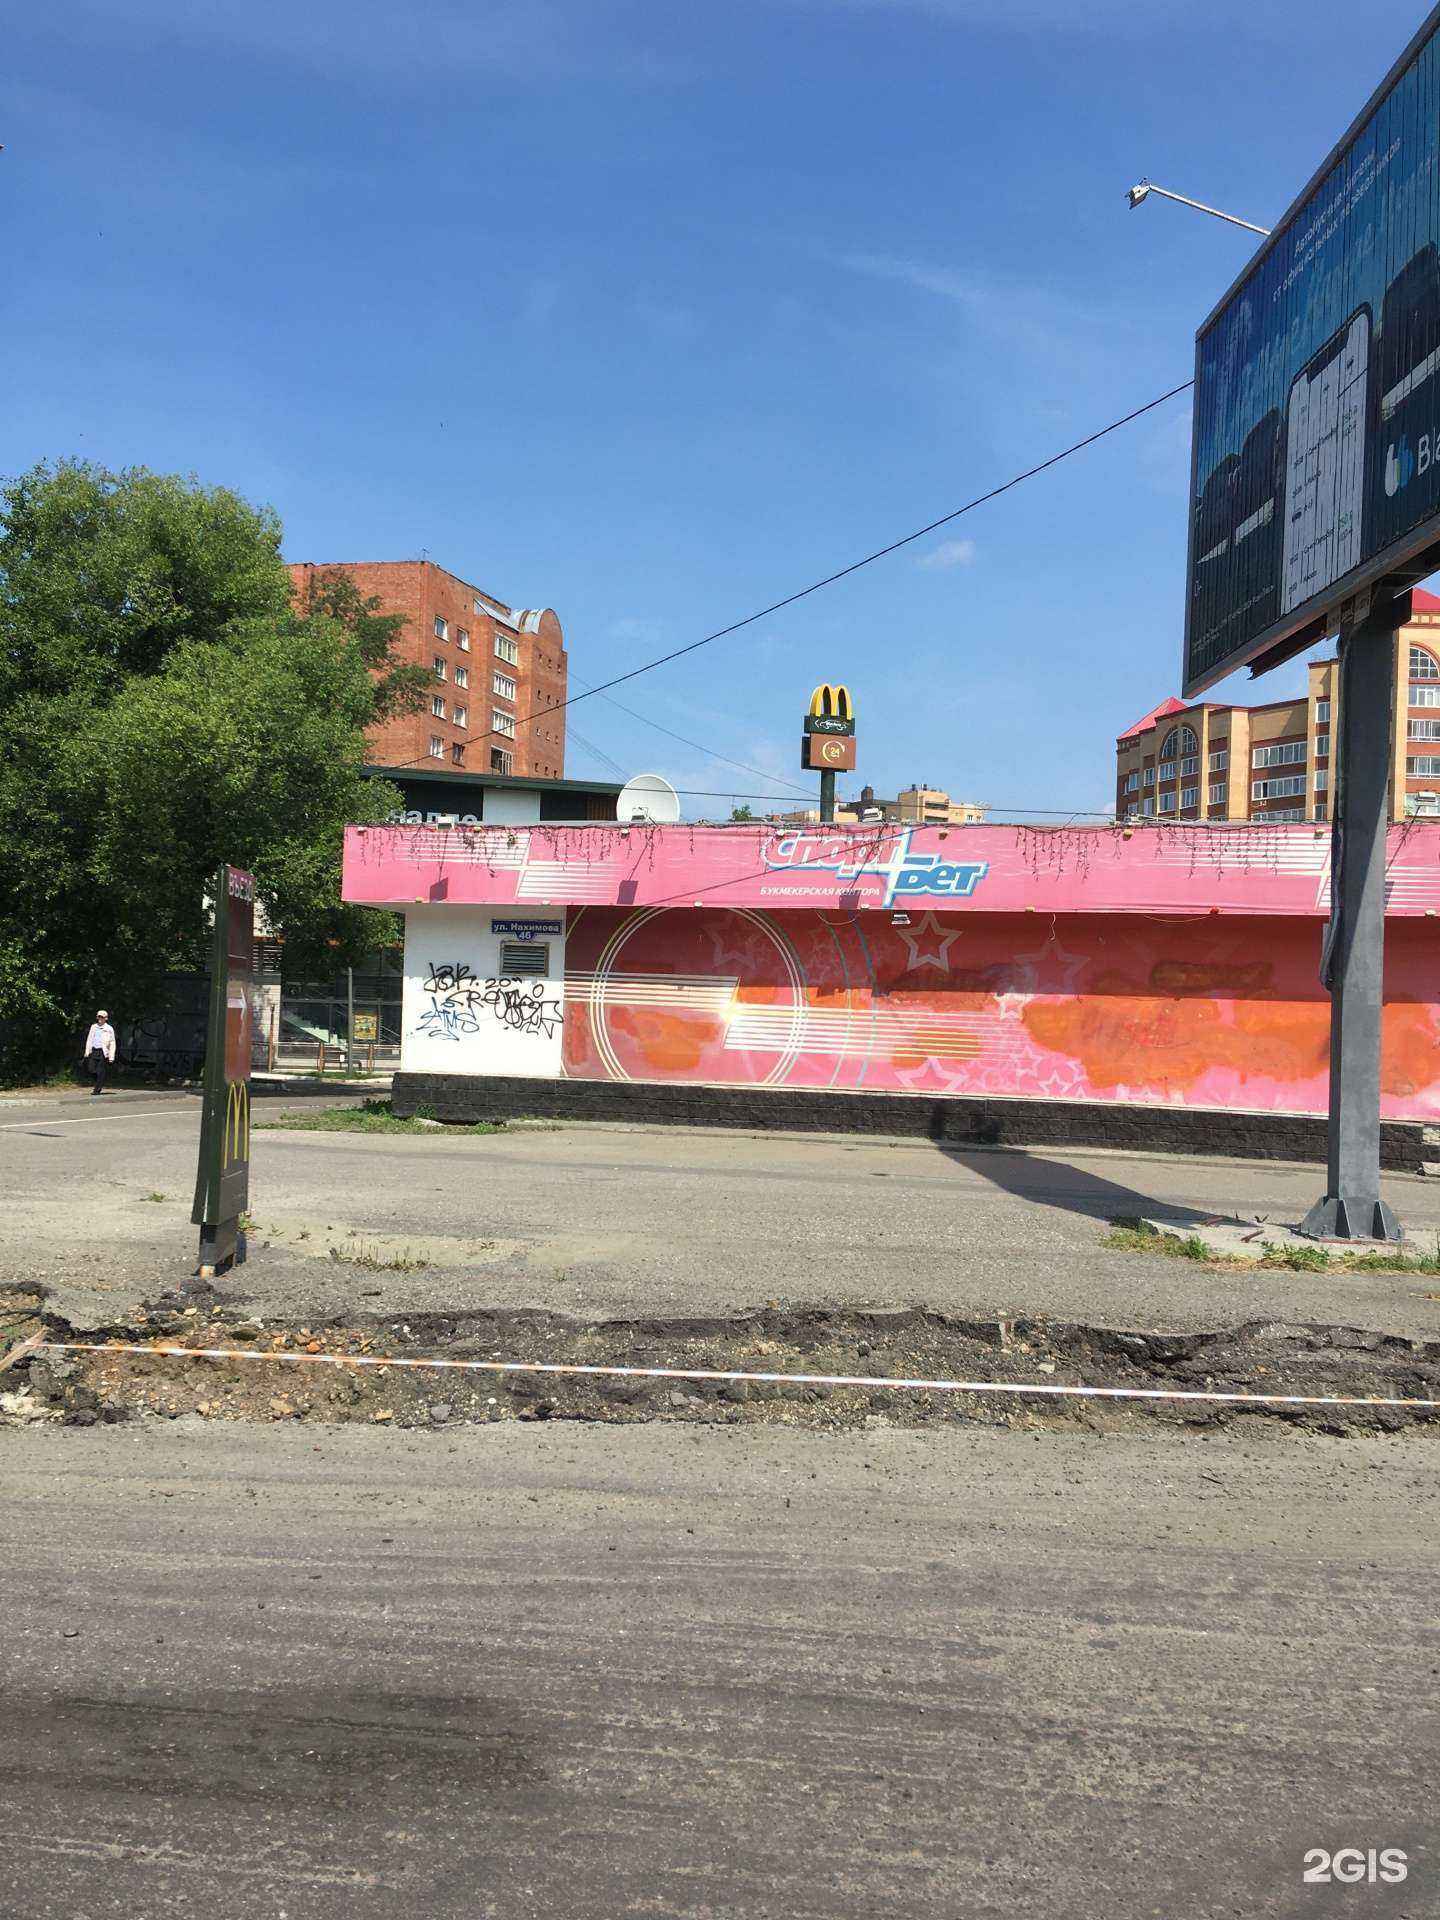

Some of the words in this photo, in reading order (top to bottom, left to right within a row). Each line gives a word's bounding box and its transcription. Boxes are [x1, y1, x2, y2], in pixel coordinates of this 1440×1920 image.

[760, 886, 834, 896] БУКМЕКЕРСКАЯ
[836, 887, 881, 896] КОНТОРА
[494, 923, 508, 931] ул.
[511, 922, 560, 932] Нахимова
